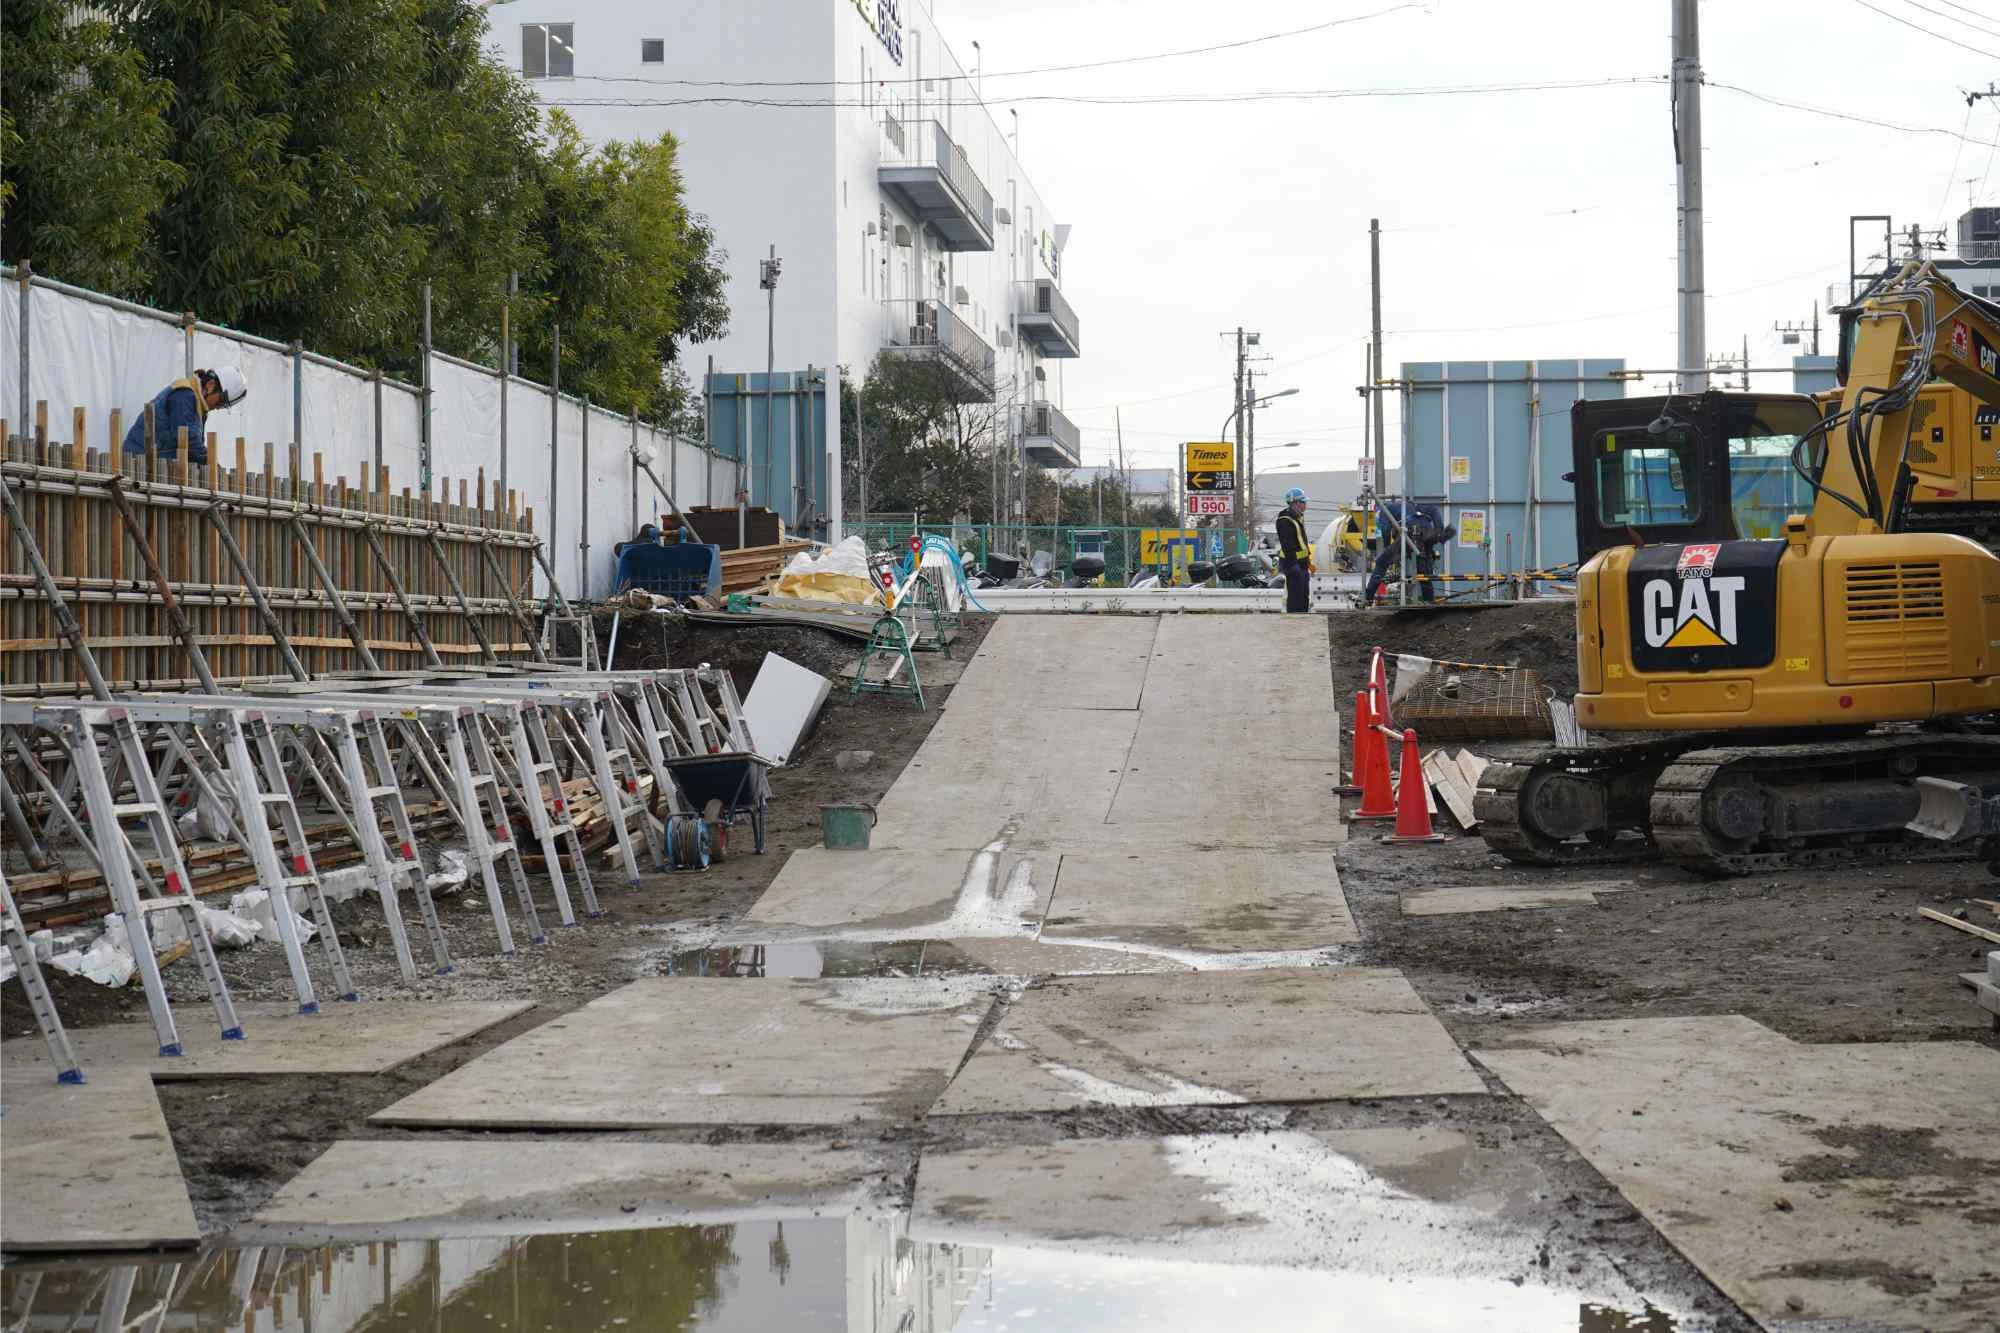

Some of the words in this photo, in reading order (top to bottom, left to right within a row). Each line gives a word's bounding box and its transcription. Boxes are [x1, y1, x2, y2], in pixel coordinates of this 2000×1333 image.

[1980, 344, 1997, 375] CAT
[1193, 449, 1229, 460] Times
[1678, 568, 1713, 578] TAIYO
[1643, 577, 1745, 647] CAT
